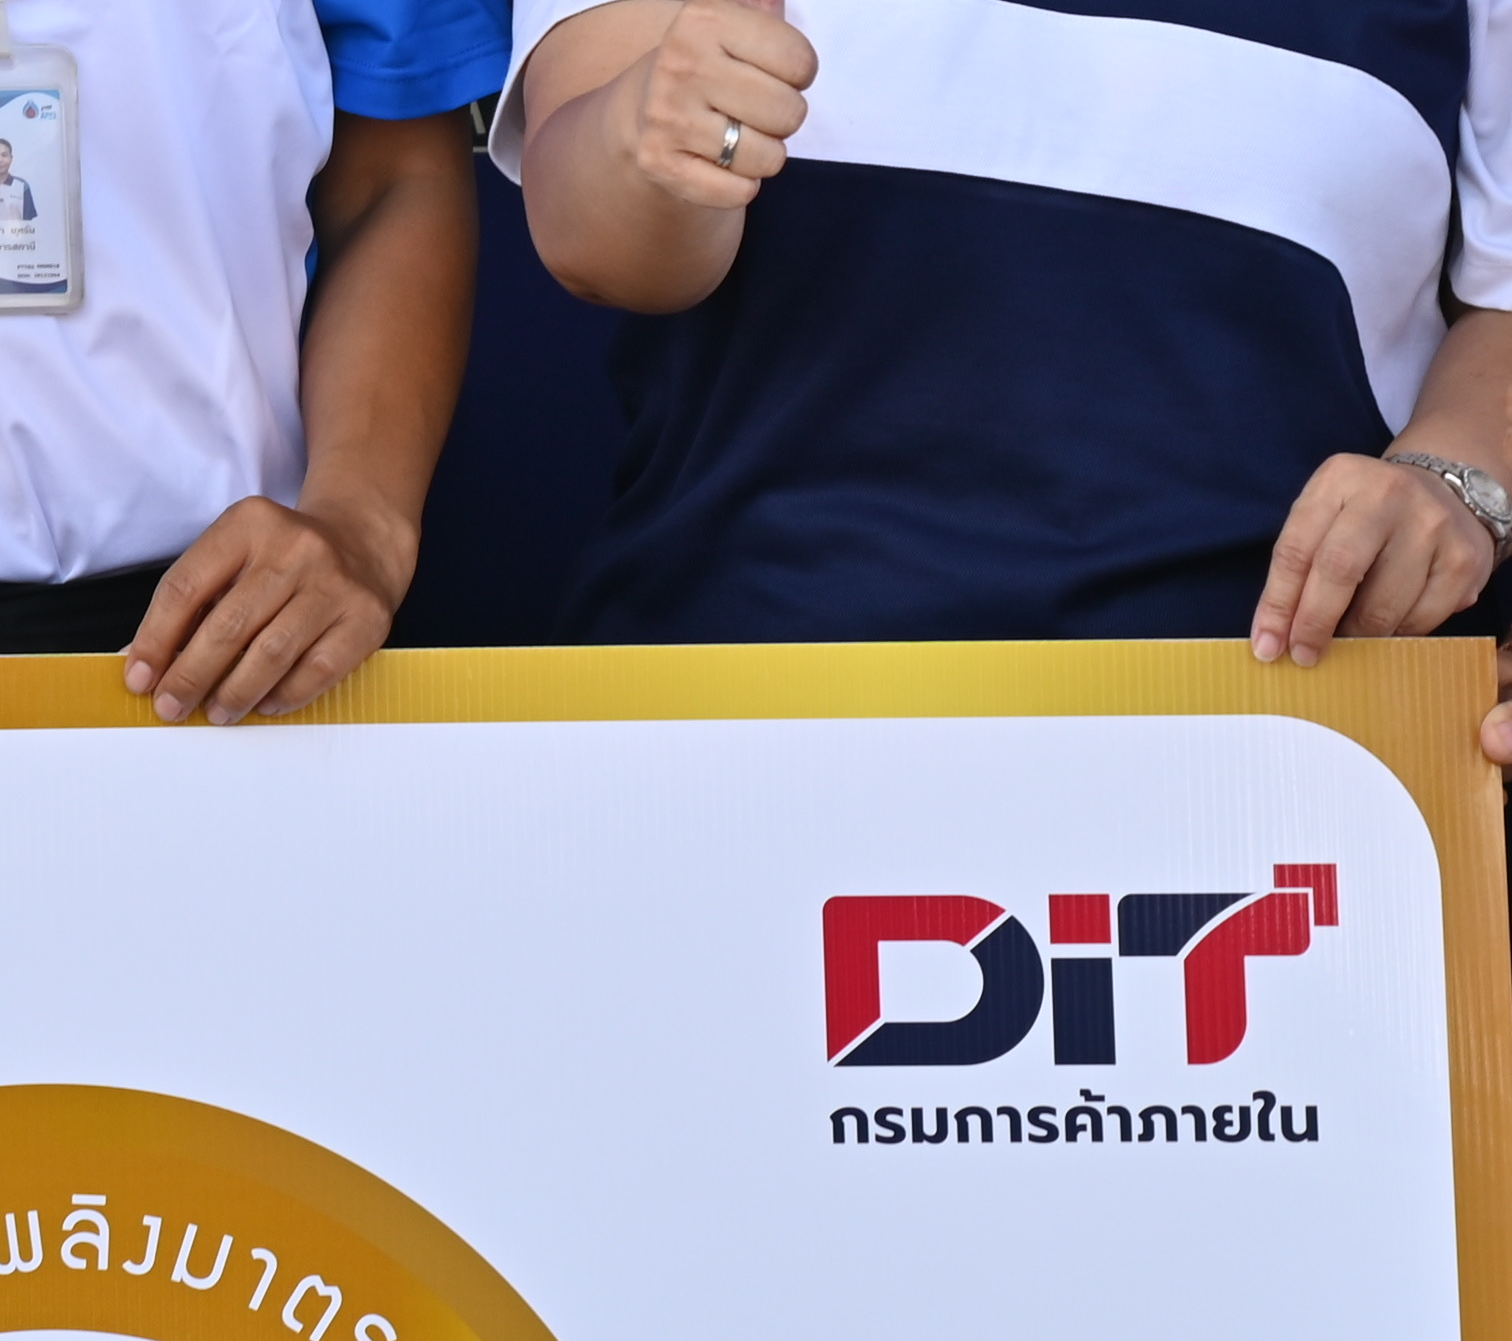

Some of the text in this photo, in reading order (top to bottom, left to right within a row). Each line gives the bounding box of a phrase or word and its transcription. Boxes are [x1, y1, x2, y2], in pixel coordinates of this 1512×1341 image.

[830, 1089, 1321, 1147] กรมการค้าภายใน
